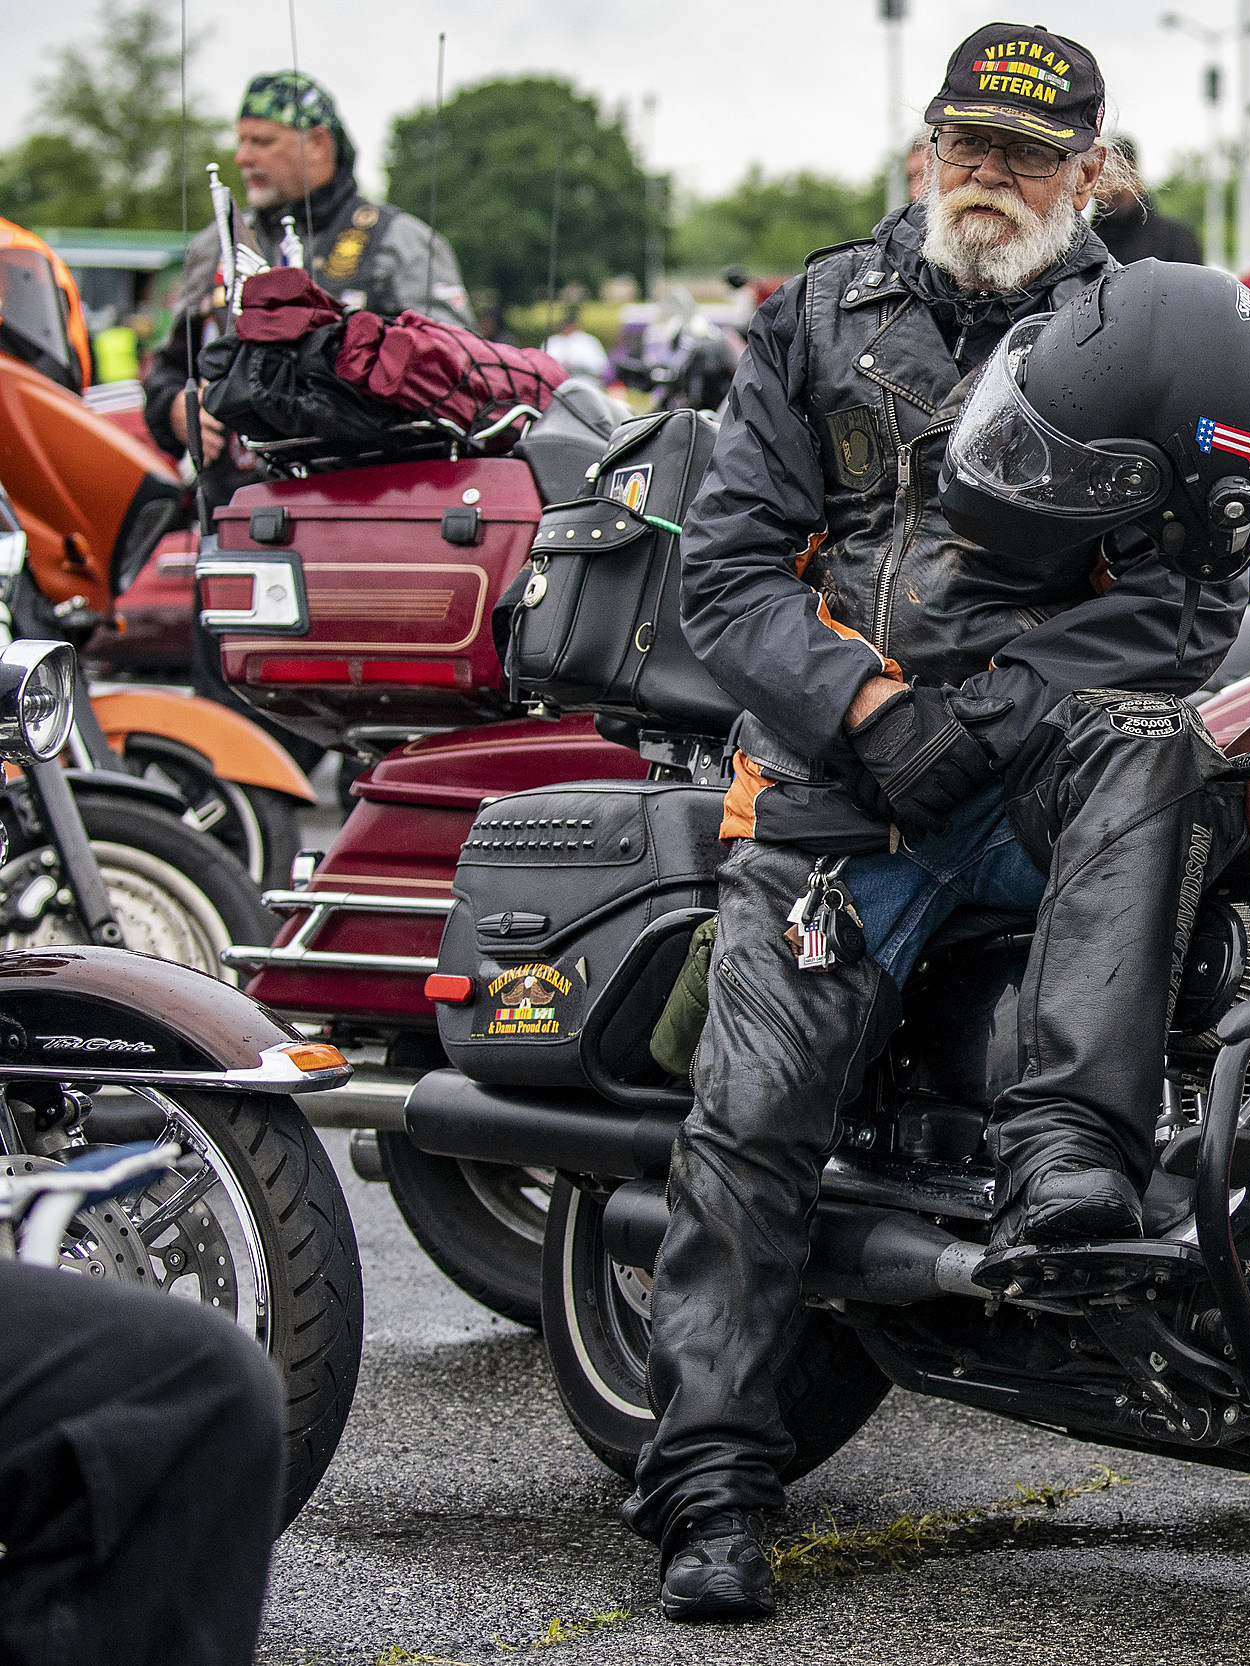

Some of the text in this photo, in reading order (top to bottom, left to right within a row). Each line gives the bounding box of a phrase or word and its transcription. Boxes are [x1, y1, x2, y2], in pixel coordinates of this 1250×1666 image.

[985, 41, 1070, 76] VIETNAM
[979, 74, 1057, 104] VETERAN
[1124, 718, 1172, 729] 250,000
[488, 963, 573, 997] VIETNAM VETERAN
[488, 1020, 560, 1034] & Damn Proud of It
